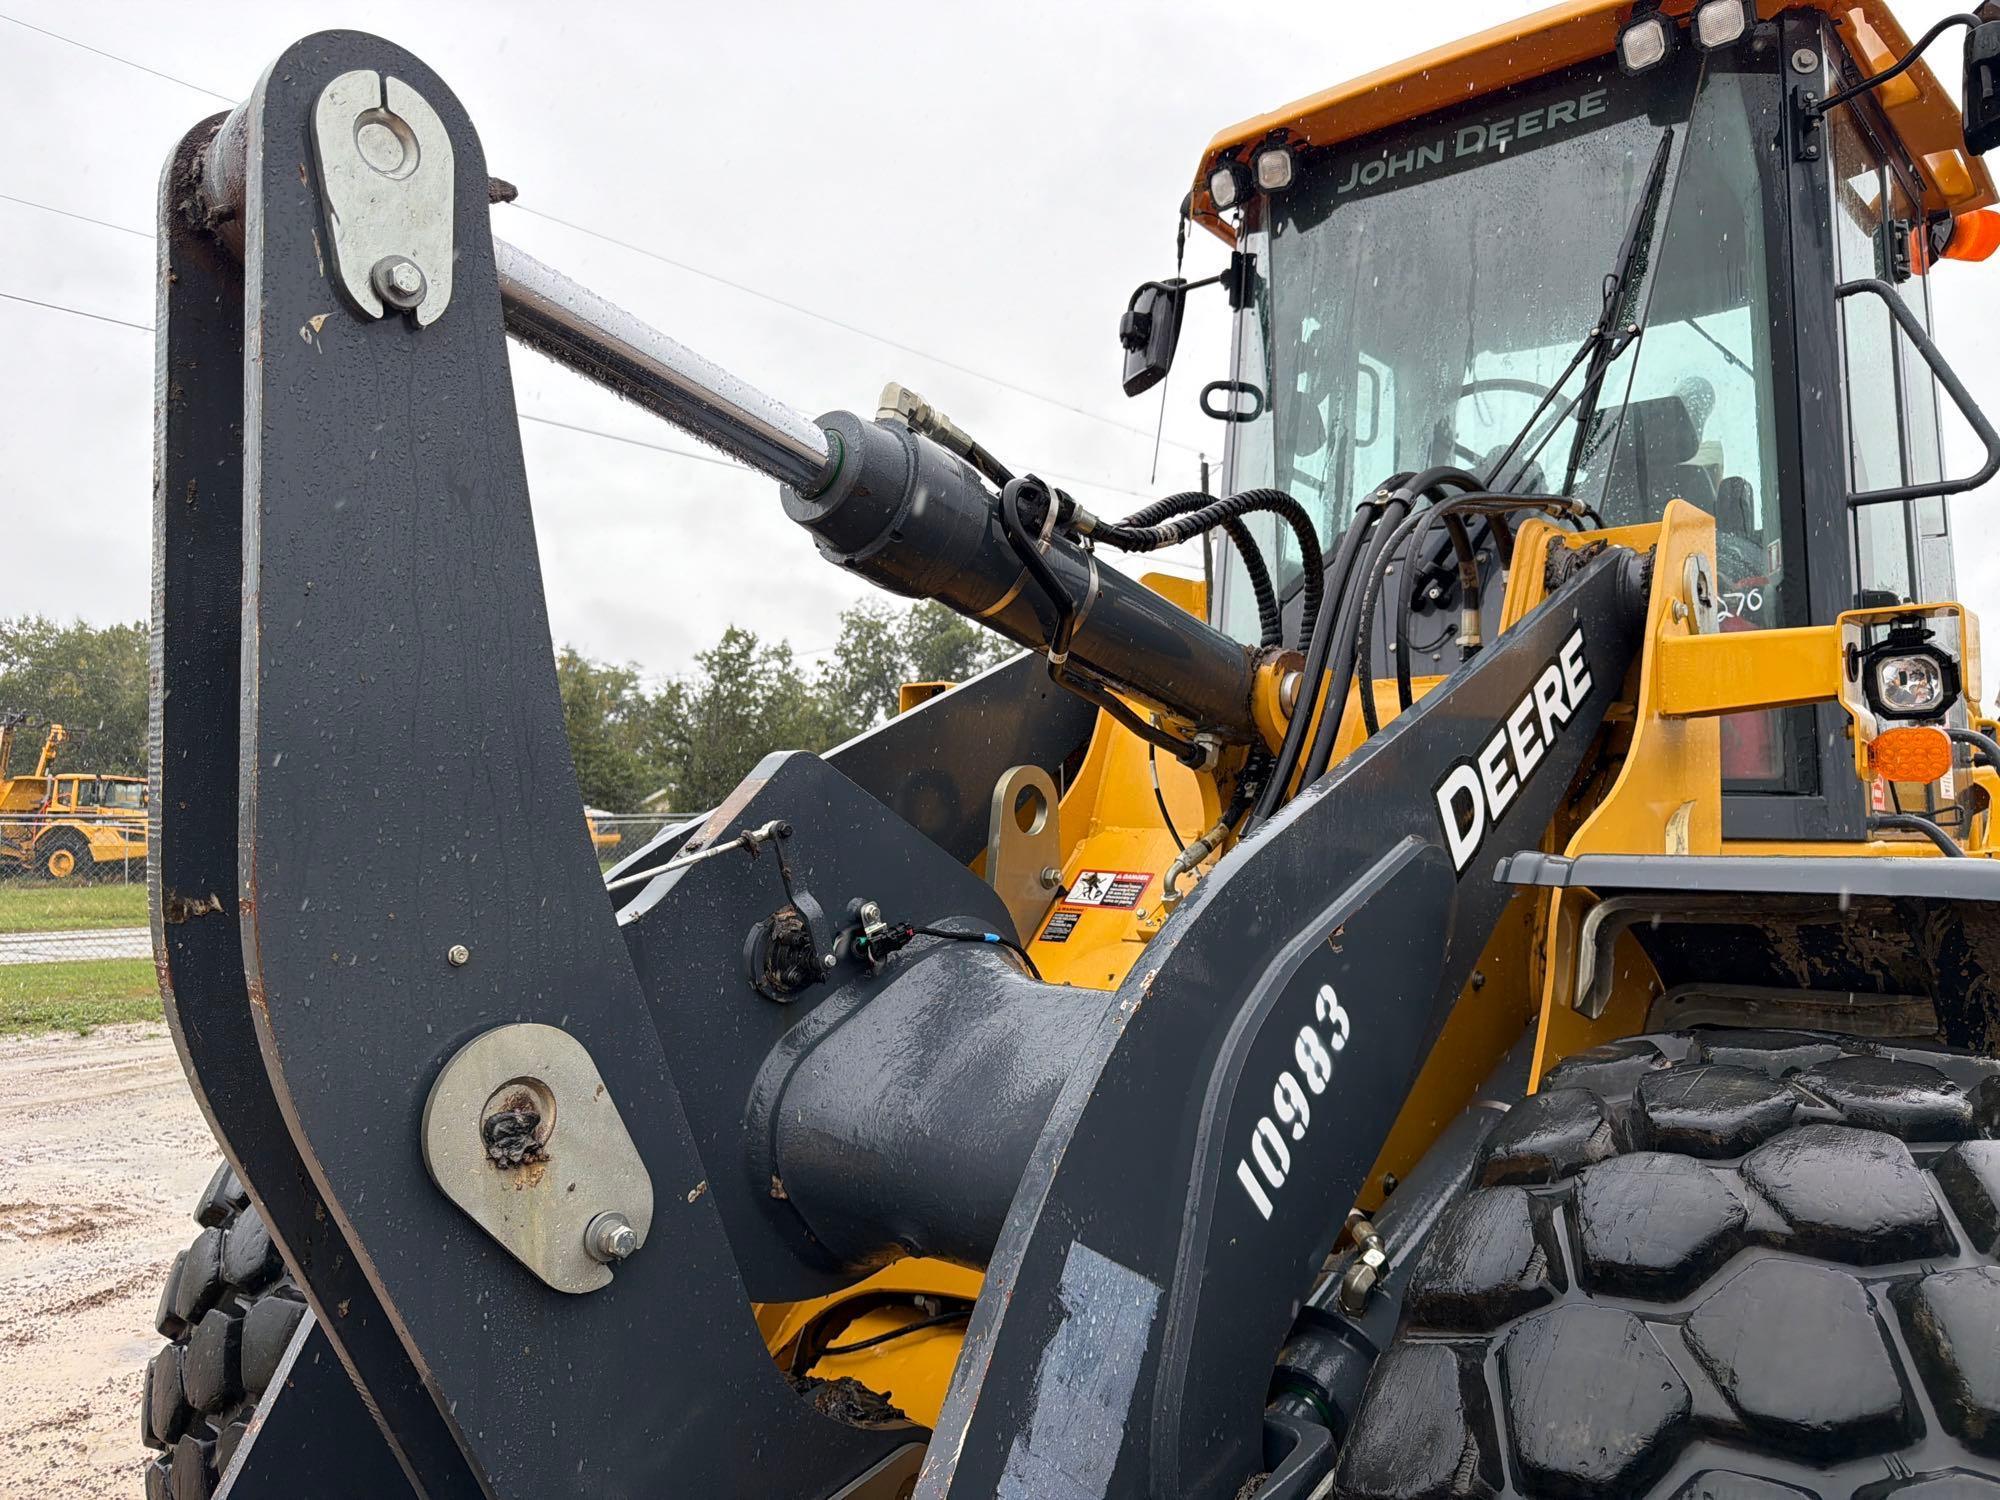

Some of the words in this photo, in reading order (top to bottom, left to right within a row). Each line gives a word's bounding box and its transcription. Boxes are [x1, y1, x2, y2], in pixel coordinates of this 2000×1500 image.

[1337, 140, 1444, 194] JOHN
[1455, 88, 1607, 158] DEERE
[1436, 628, 1593, 873] DEERE
[1122, 873, 1150, 881] DANGER
[1237, 984, 1350, 1221] 10983
